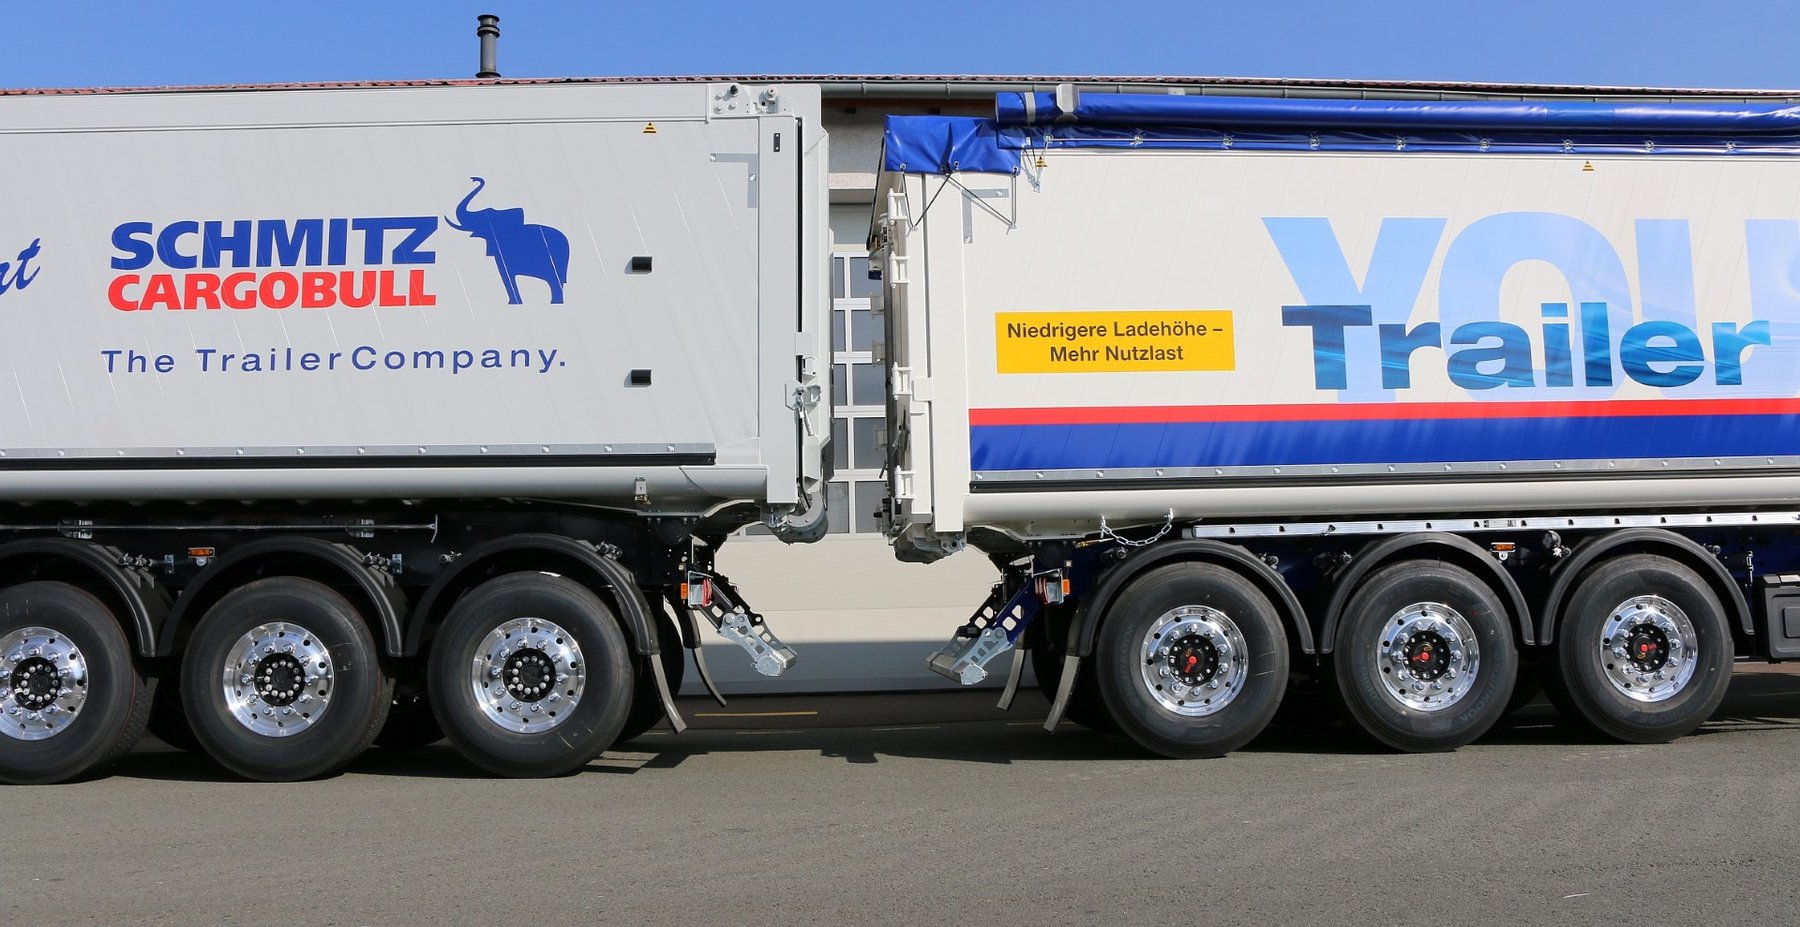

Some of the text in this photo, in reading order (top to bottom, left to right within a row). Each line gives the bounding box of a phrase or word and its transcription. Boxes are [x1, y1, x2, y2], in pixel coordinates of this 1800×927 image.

[110, 216, 439, 270] SCHMITZ
[108, 268, 437, 312] CARGOBULL
[1007, 321, 1107, 341] Niedrigere
[1114, 320, 1208, 337] Ladehöhe
[1281, 302, 1772, 391] Trailer
[101, 350, 175, 374] The
[1050, 345, 1184, 362] Mehr Nutzlast
